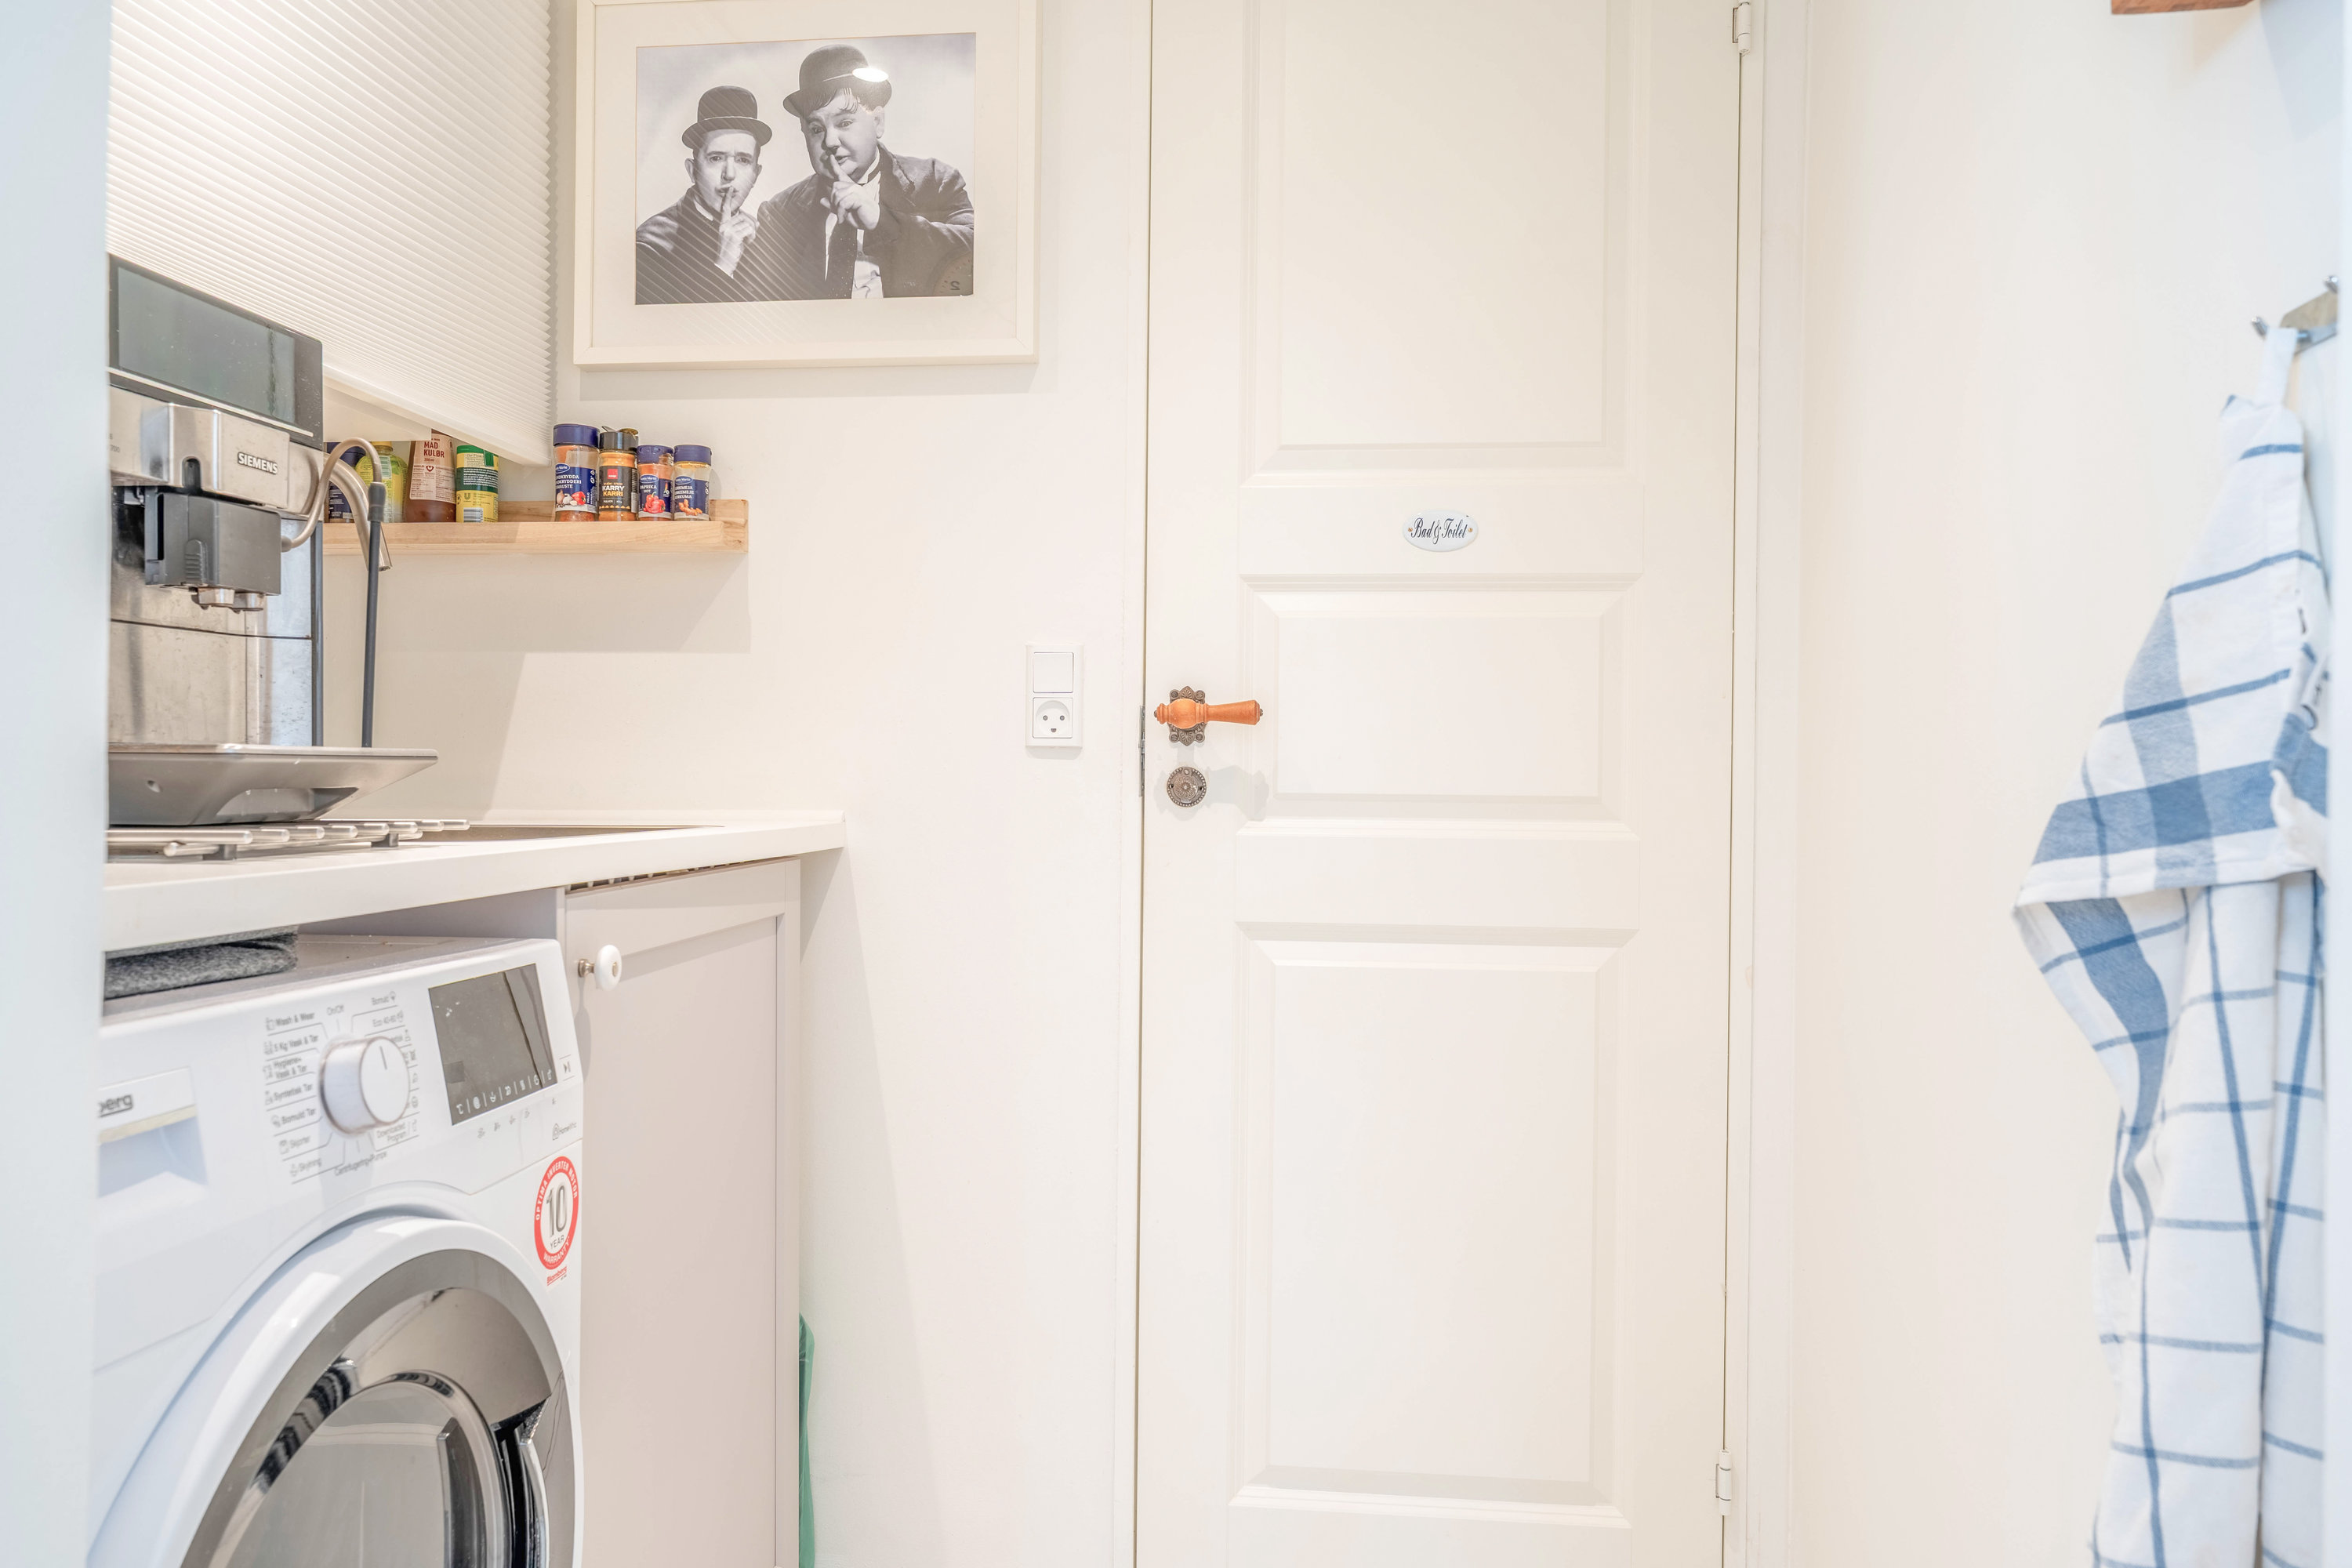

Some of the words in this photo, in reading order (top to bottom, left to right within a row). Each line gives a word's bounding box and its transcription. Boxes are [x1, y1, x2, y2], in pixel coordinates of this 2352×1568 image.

[238, 452, 278, 474] SIEMENS
[423, 449, 445, 458] KULØR
[1411, 517, 1436, 538] Bad
[1442, 517, 1468, 539] Toilet
[535, 1179, 549, 1221] OPTIMA
[546, 1160, 569, 1180] INVERTER
[568, 1167, 578, 1199] MOTOR
[546, 1185, 568, 1237] 10
[550, 1234, 565, 1250] YEAR
